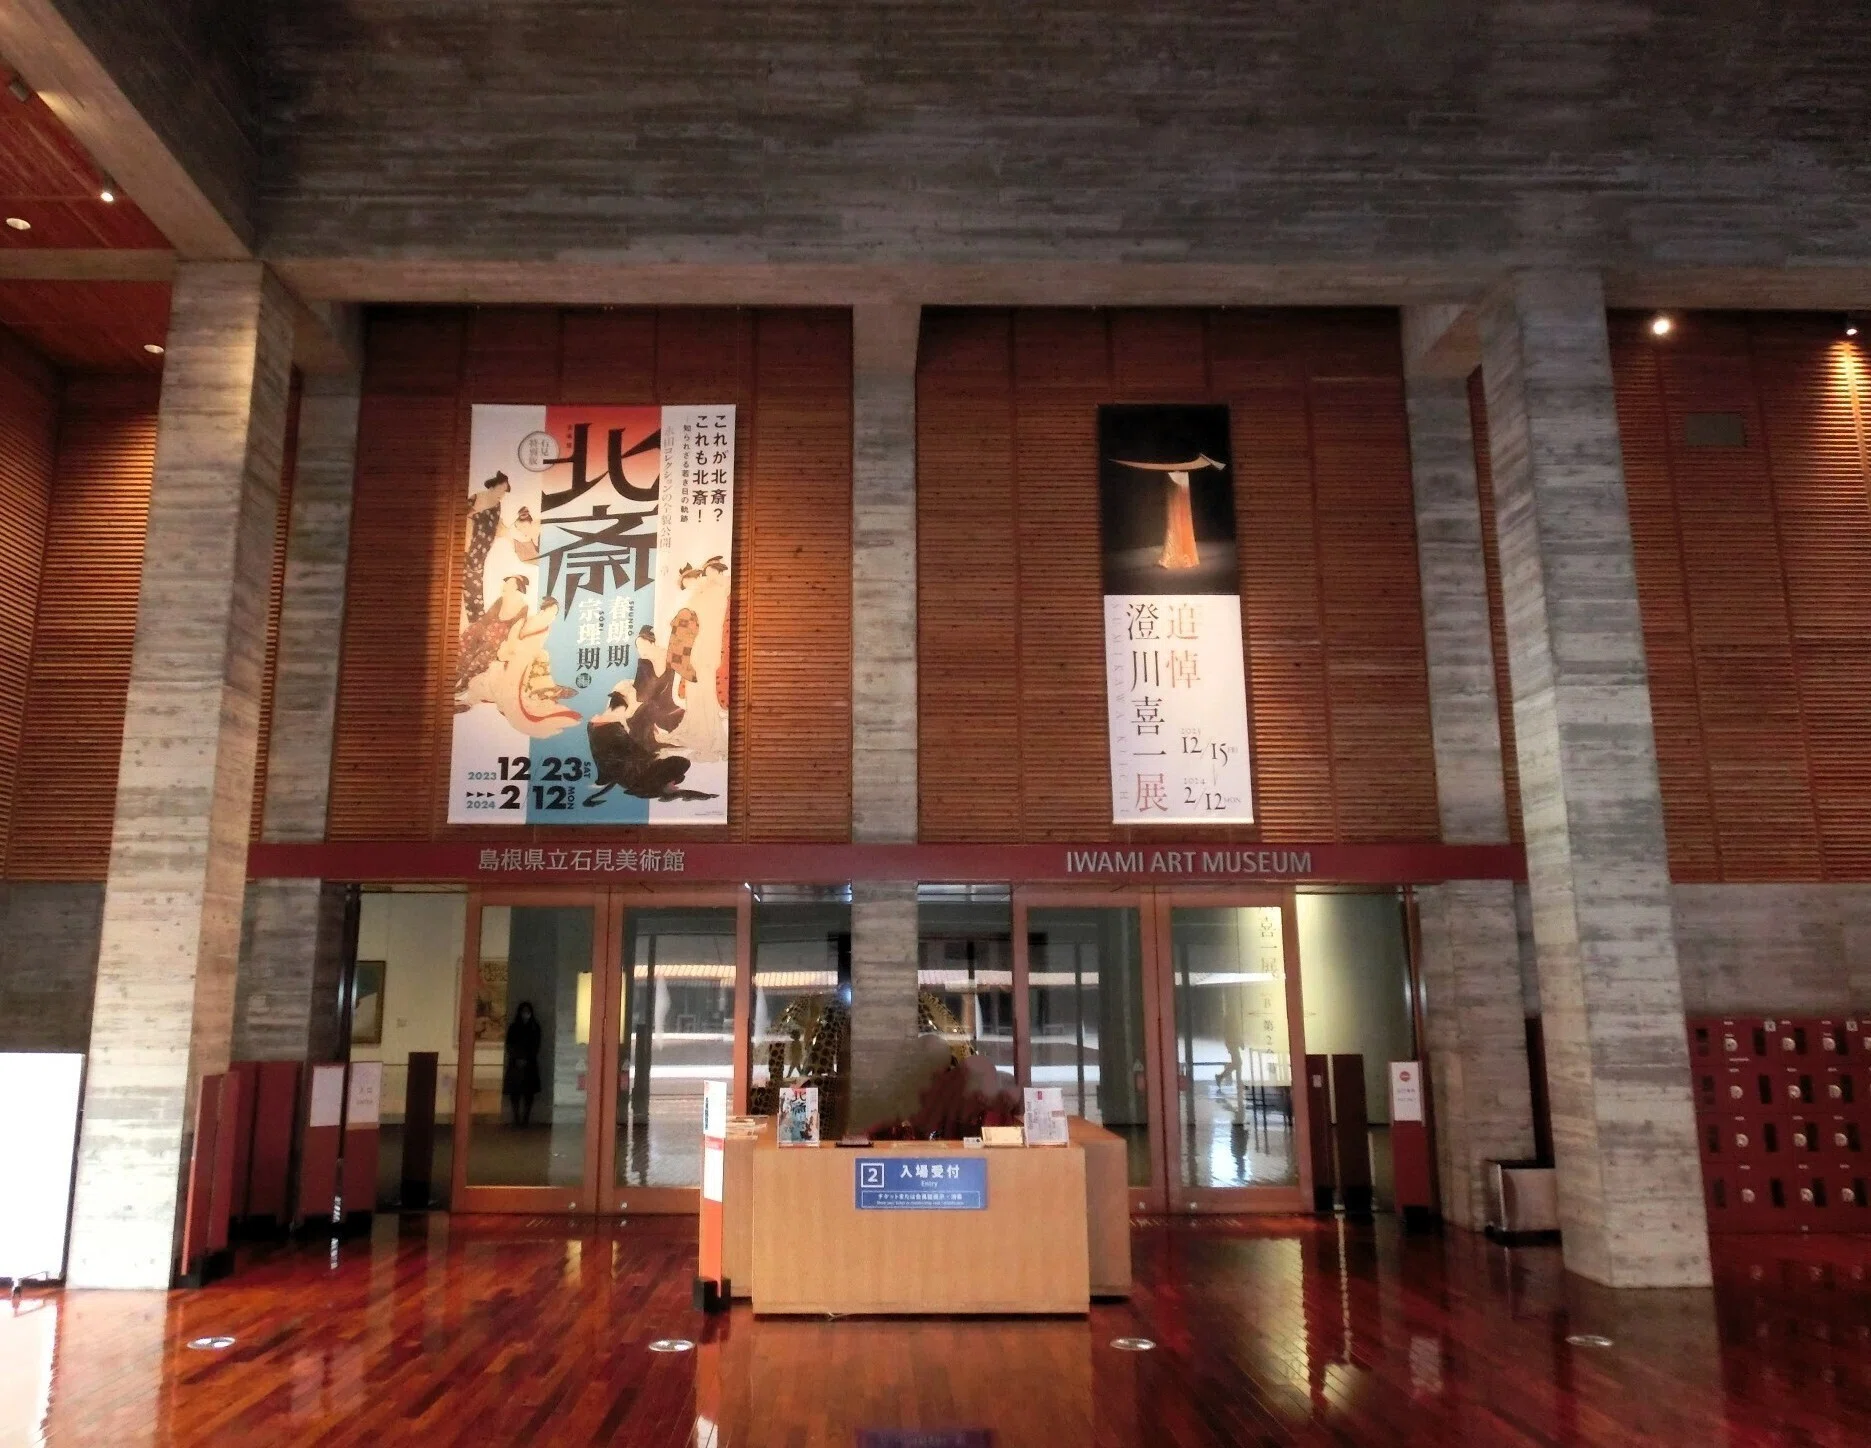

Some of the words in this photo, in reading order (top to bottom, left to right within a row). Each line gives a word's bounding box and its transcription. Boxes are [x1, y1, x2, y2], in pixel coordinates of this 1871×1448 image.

[526, 422, 661, 621] 北斎
[468, 771, 497, 780] 2023
[497, 756, 531, 781] 12
[541, 756, 583, 782] 23
[583, 761, 591, 778] SAT
[466, 800, 496, 809] 2024
[498, 784, 521, 810] 2
[532, 785, 567, 810] 12
[567, 786, 575, 810] MON
[478, 848, 686, 873] 島根県立石見美術館
[1066, 851, 1145, 873] IWAMI
[1150, 851, 1196, 873] ART
[1203, 851, 1313, 873] MUSEUM
[867, 1168, 878, 1183] 2
[900, 1164, 960, 1179] 入場受付
